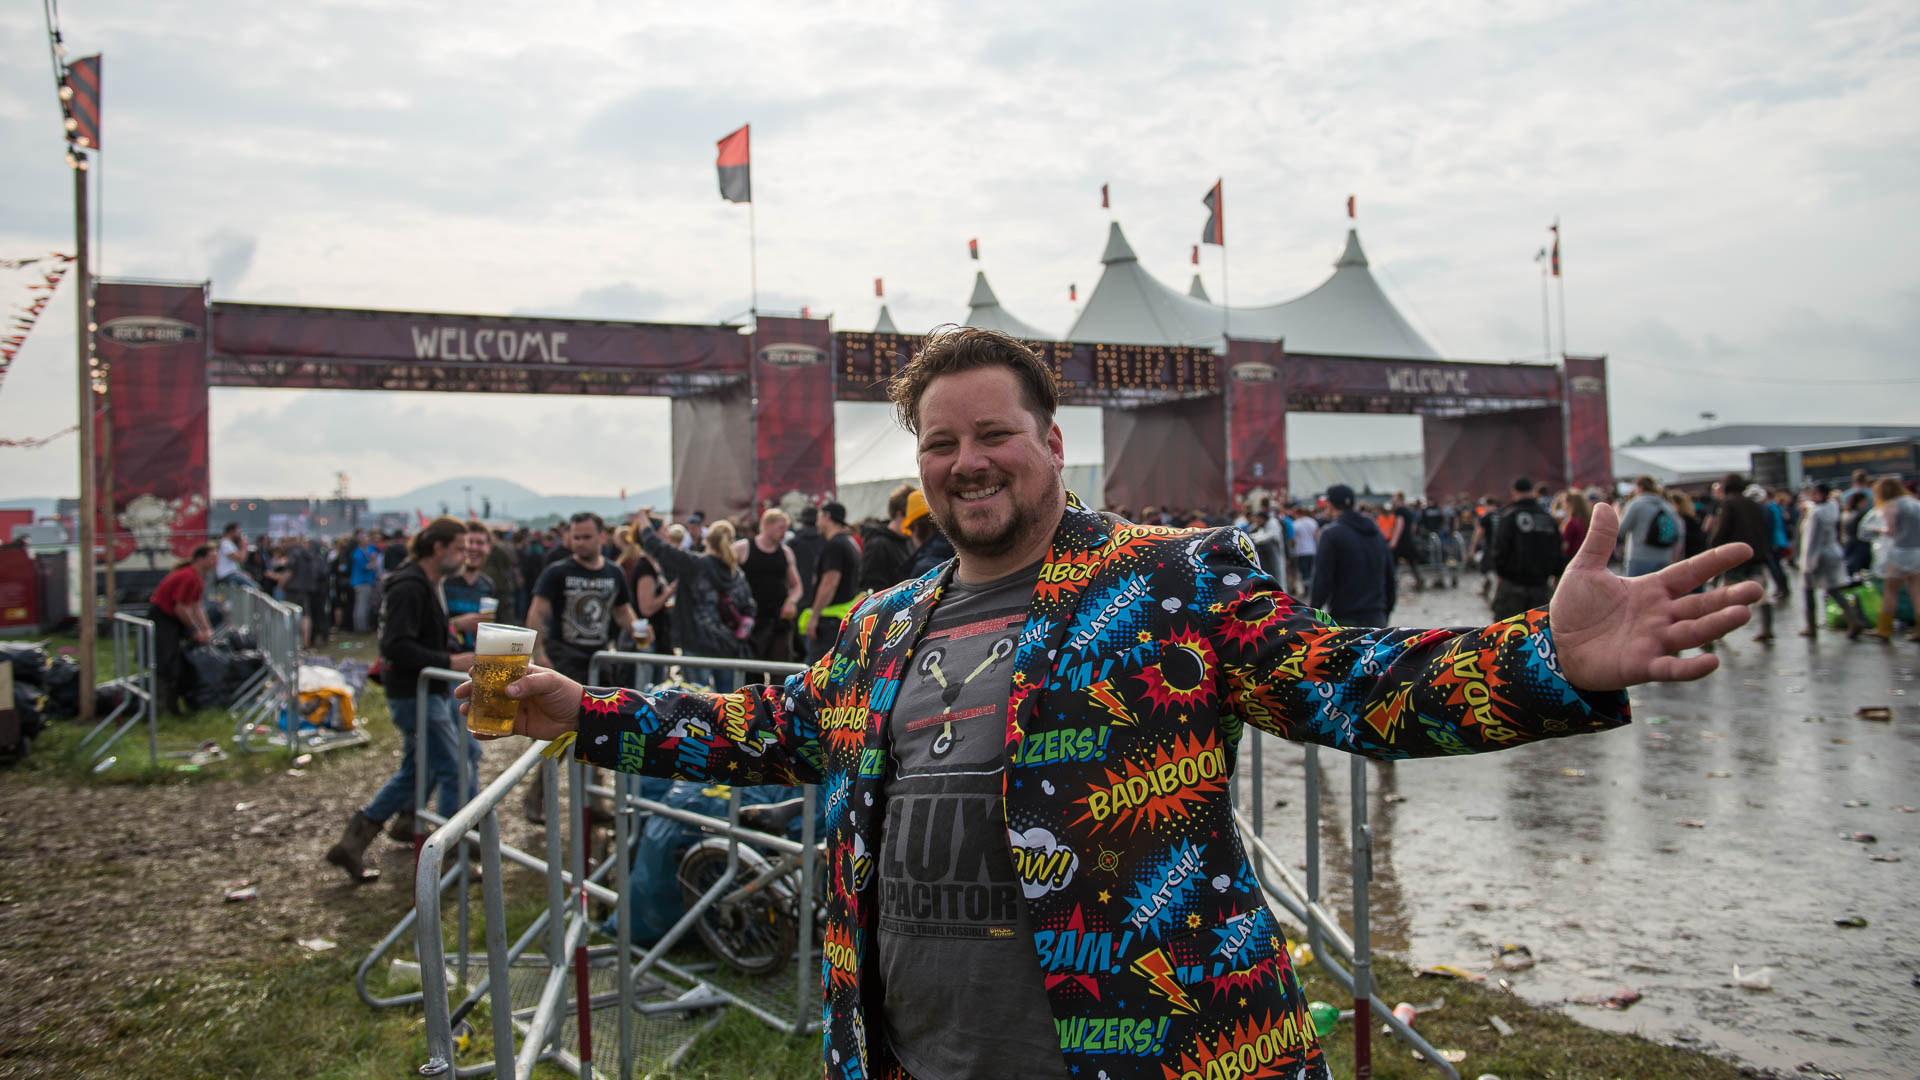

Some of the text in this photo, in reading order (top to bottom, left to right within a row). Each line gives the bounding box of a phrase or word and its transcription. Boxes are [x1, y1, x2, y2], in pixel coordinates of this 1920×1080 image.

[411, 326, 569, 364] WELCOME
[1385, 366, 1472, 395] WELCOME
[1070, 574, 1151, 651] KLATSCH!!
[1034, 930, 1135, 975] BAM!
